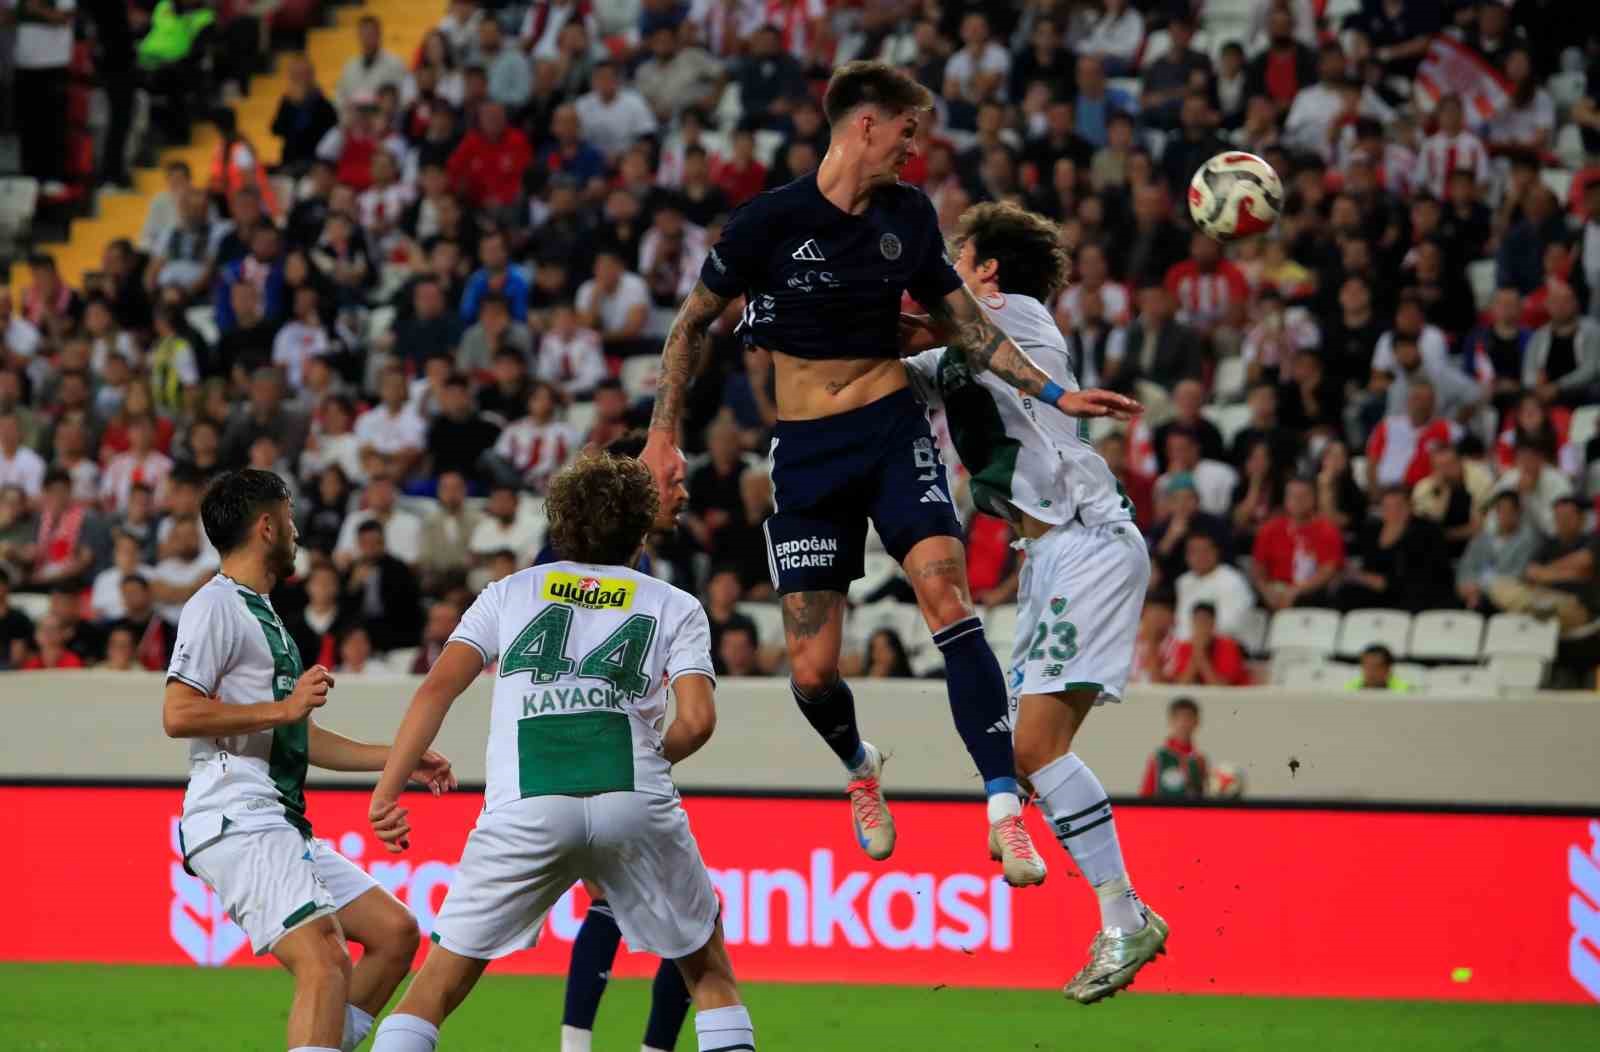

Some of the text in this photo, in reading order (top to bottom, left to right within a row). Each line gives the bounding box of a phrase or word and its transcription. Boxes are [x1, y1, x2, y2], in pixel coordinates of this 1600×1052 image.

[775, 536, 837, 557] ERDOĞAN
[780, 554, 835, 571] TİCARET
[550, 582, 627, 607] uludağ
[500, 603, 657, 700] 44
[1028, 621, 1078, 662] 23
[522, 687, 625, 717] KAYACIK
[705, 848, 1012, 952] ankası
